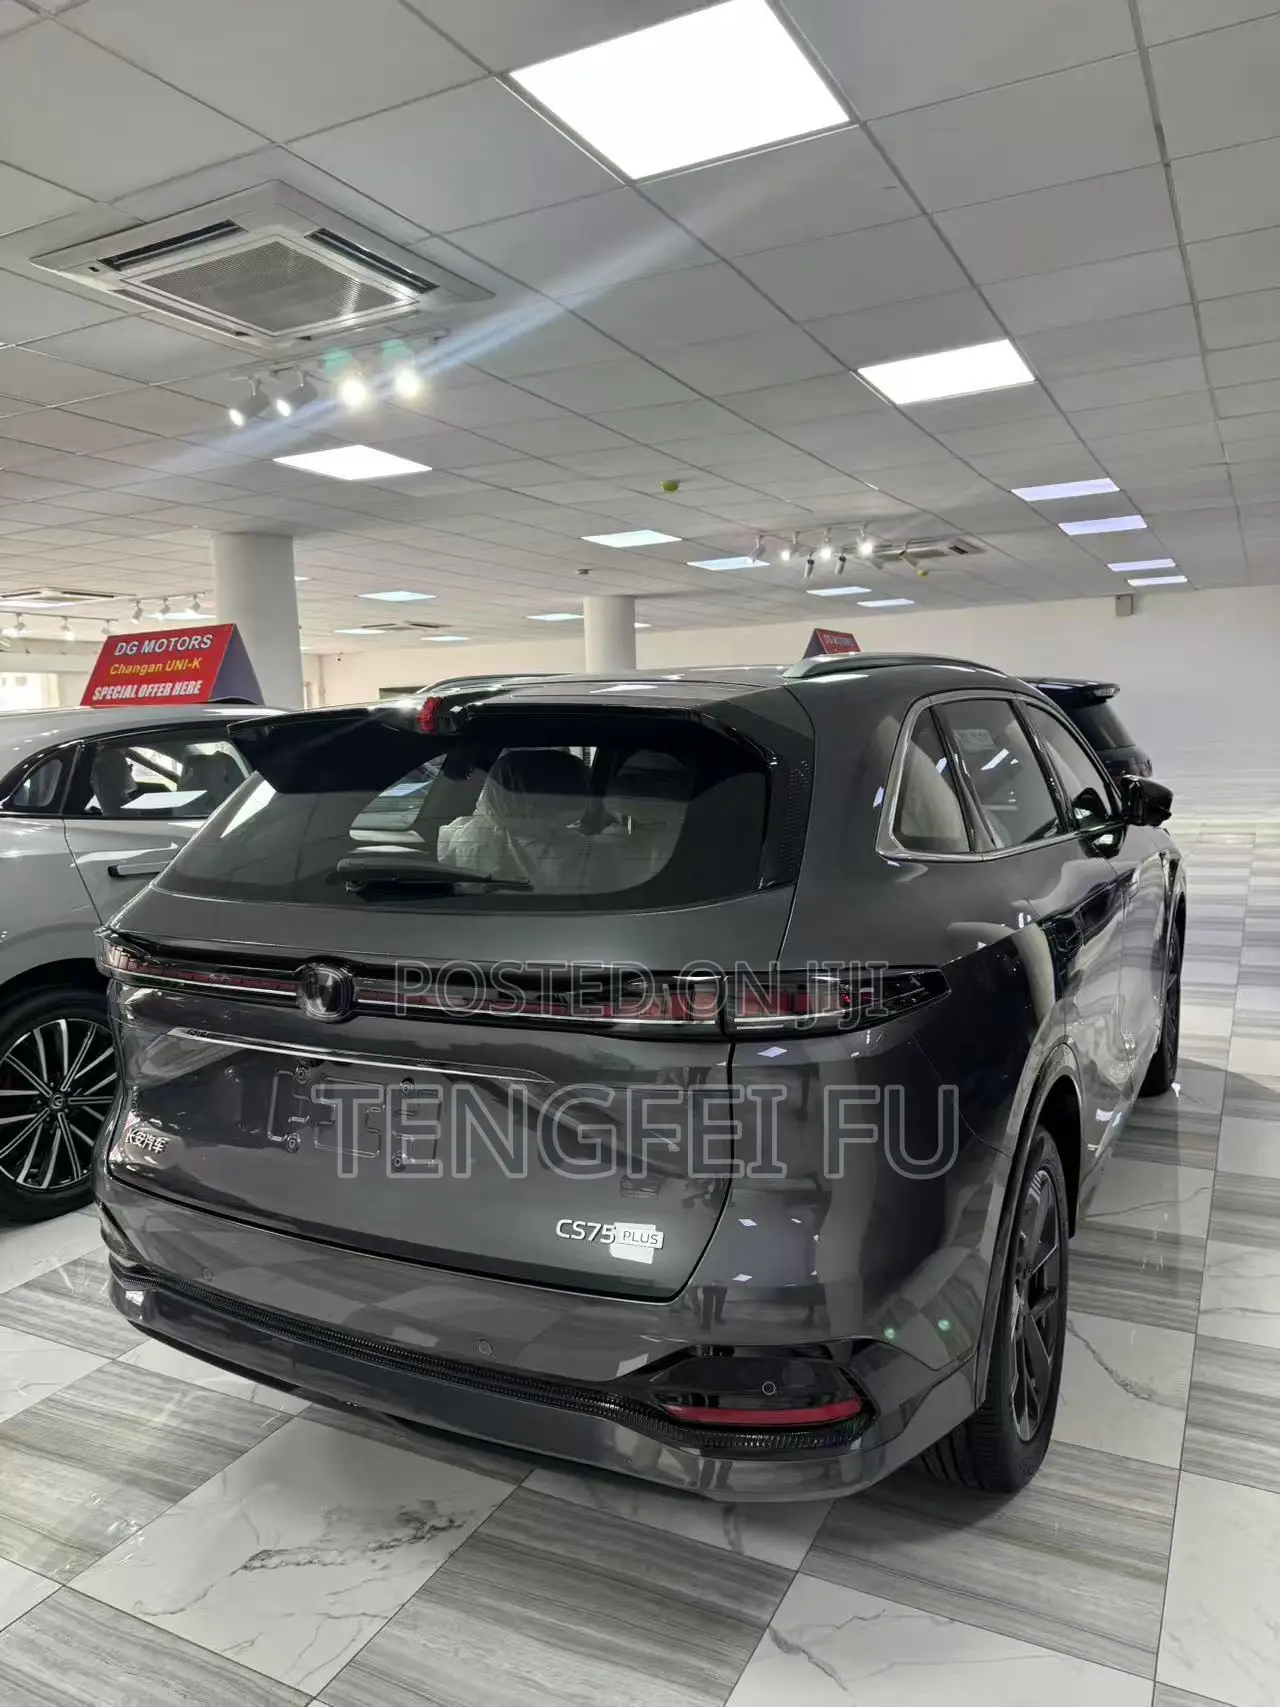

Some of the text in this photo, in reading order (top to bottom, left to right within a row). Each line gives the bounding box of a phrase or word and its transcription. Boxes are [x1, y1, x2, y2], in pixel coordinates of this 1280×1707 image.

[114, 634, 213, 656] DG MOTORS
[110, 657, 201, 676] Changan UNI-K
[92, 680, 203, 700] SPECIAL OFFER HERE
[555, 1219, 659, 1245] CS75 PLUS
